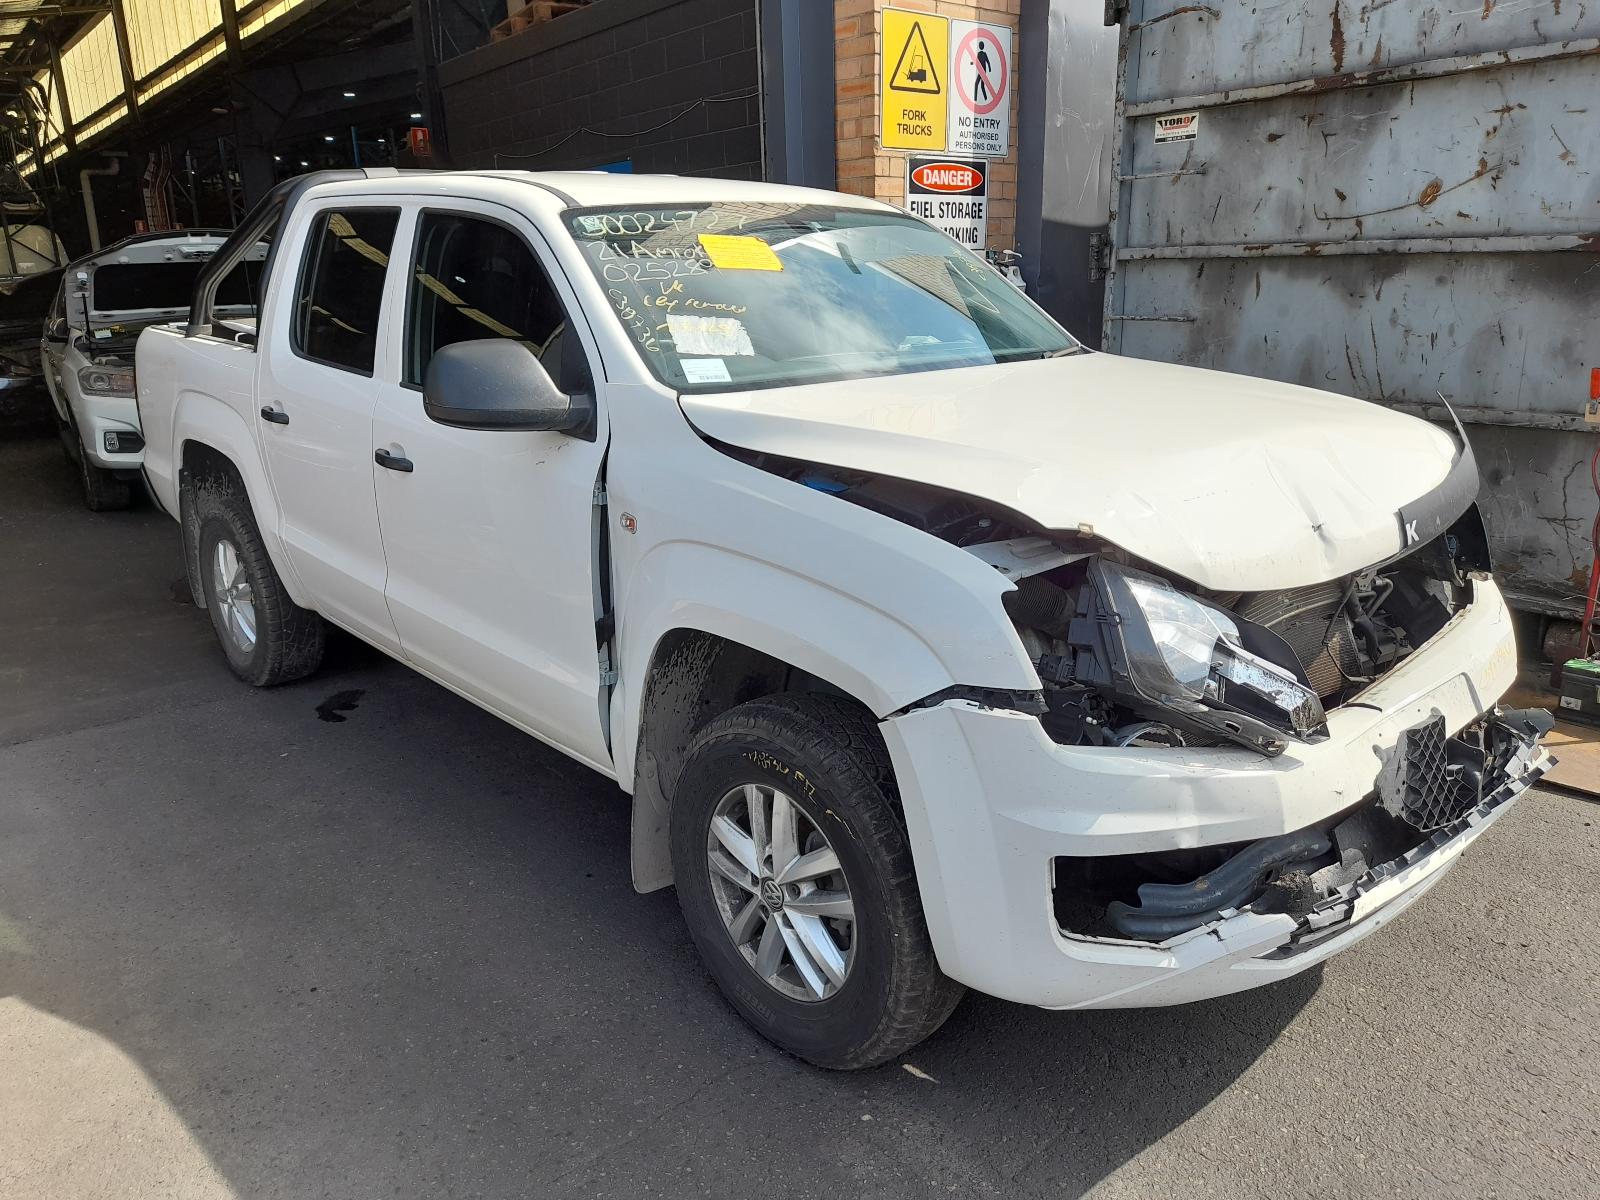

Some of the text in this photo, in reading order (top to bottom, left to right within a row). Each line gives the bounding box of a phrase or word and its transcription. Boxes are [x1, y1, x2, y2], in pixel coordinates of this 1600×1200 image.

[902, 109, 927, 121] FORK
[1164, 117, 1190, 126] TORO
[896, 123, 932, 136] TRUCKS
[958, 116, 1001, 130] NO ENTRY
[959, 130, 999, 141] AUTHORISED
[955, 140, 1002, 152] PERSONS ONLY
[923, 168, 973, 186] DANGER
[938, 201, 983, 220] STORAGE
[940, 226, 978, 244] OKING
[1405, 519, 1420, 546] K
